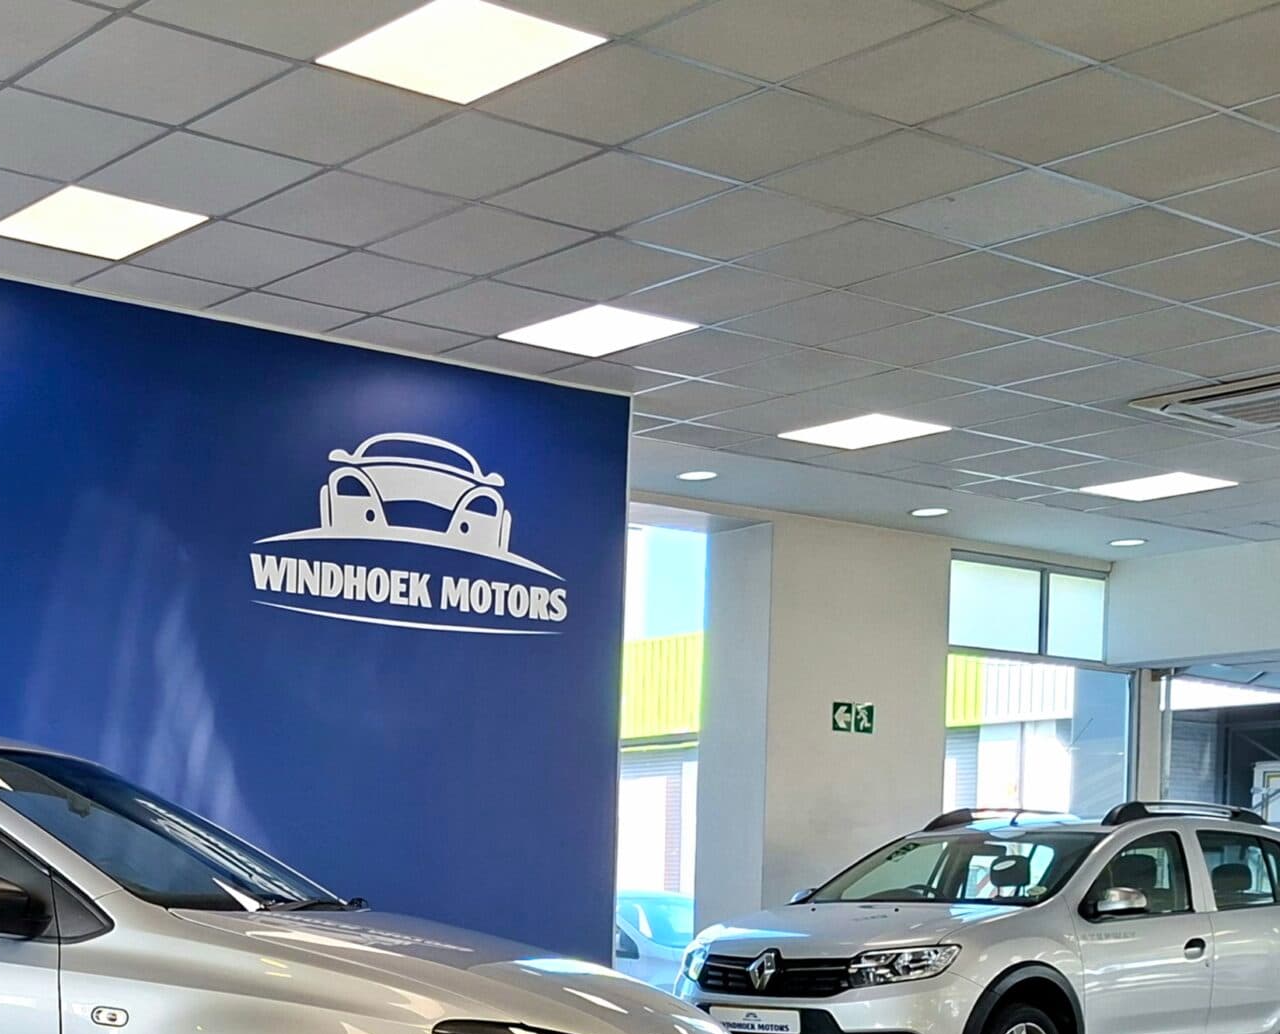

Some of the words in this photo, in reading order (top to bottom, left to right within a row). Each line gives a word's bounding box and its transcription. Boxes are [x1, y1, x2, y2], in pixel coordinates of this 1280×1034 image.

[250, 553, 432, 609] WINDHOEK
[440, 576, 568, 622] MOTORS
[758, 1023, 790, 1032] MOTORS
